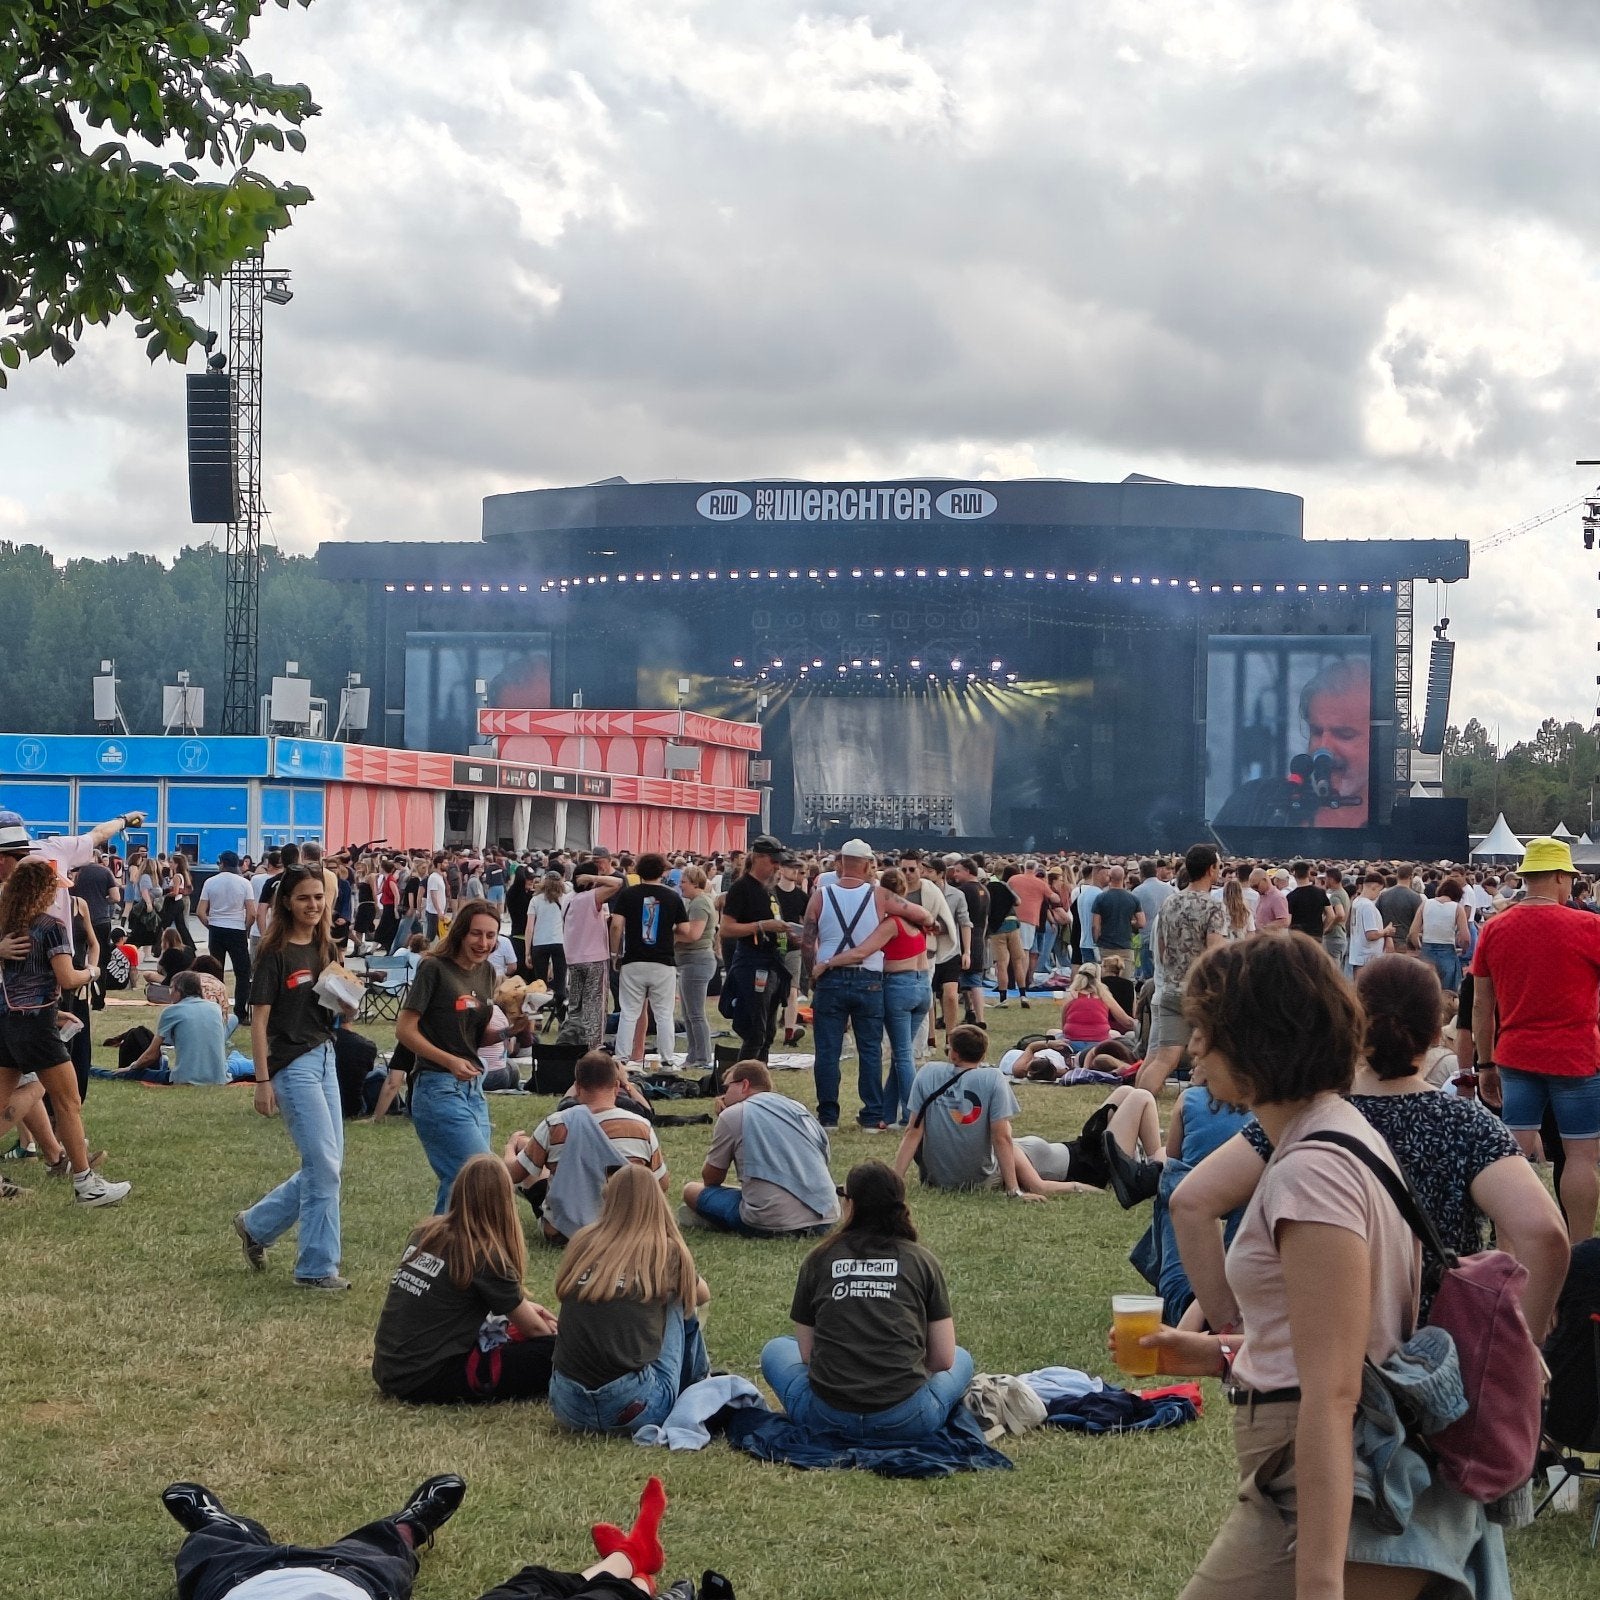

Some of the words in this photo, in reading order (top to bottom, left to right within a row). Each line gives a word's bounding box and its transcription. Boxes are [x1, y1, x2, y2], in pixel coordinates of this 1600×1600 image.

[710, 495, 738, 515] RW
[951, 493, 982, 514] RW
[835, 1262, 857, 1274] eco
[850, 1280, 897, 1291] REFRESH
[849, 1289, 891, 1299] RETURN
